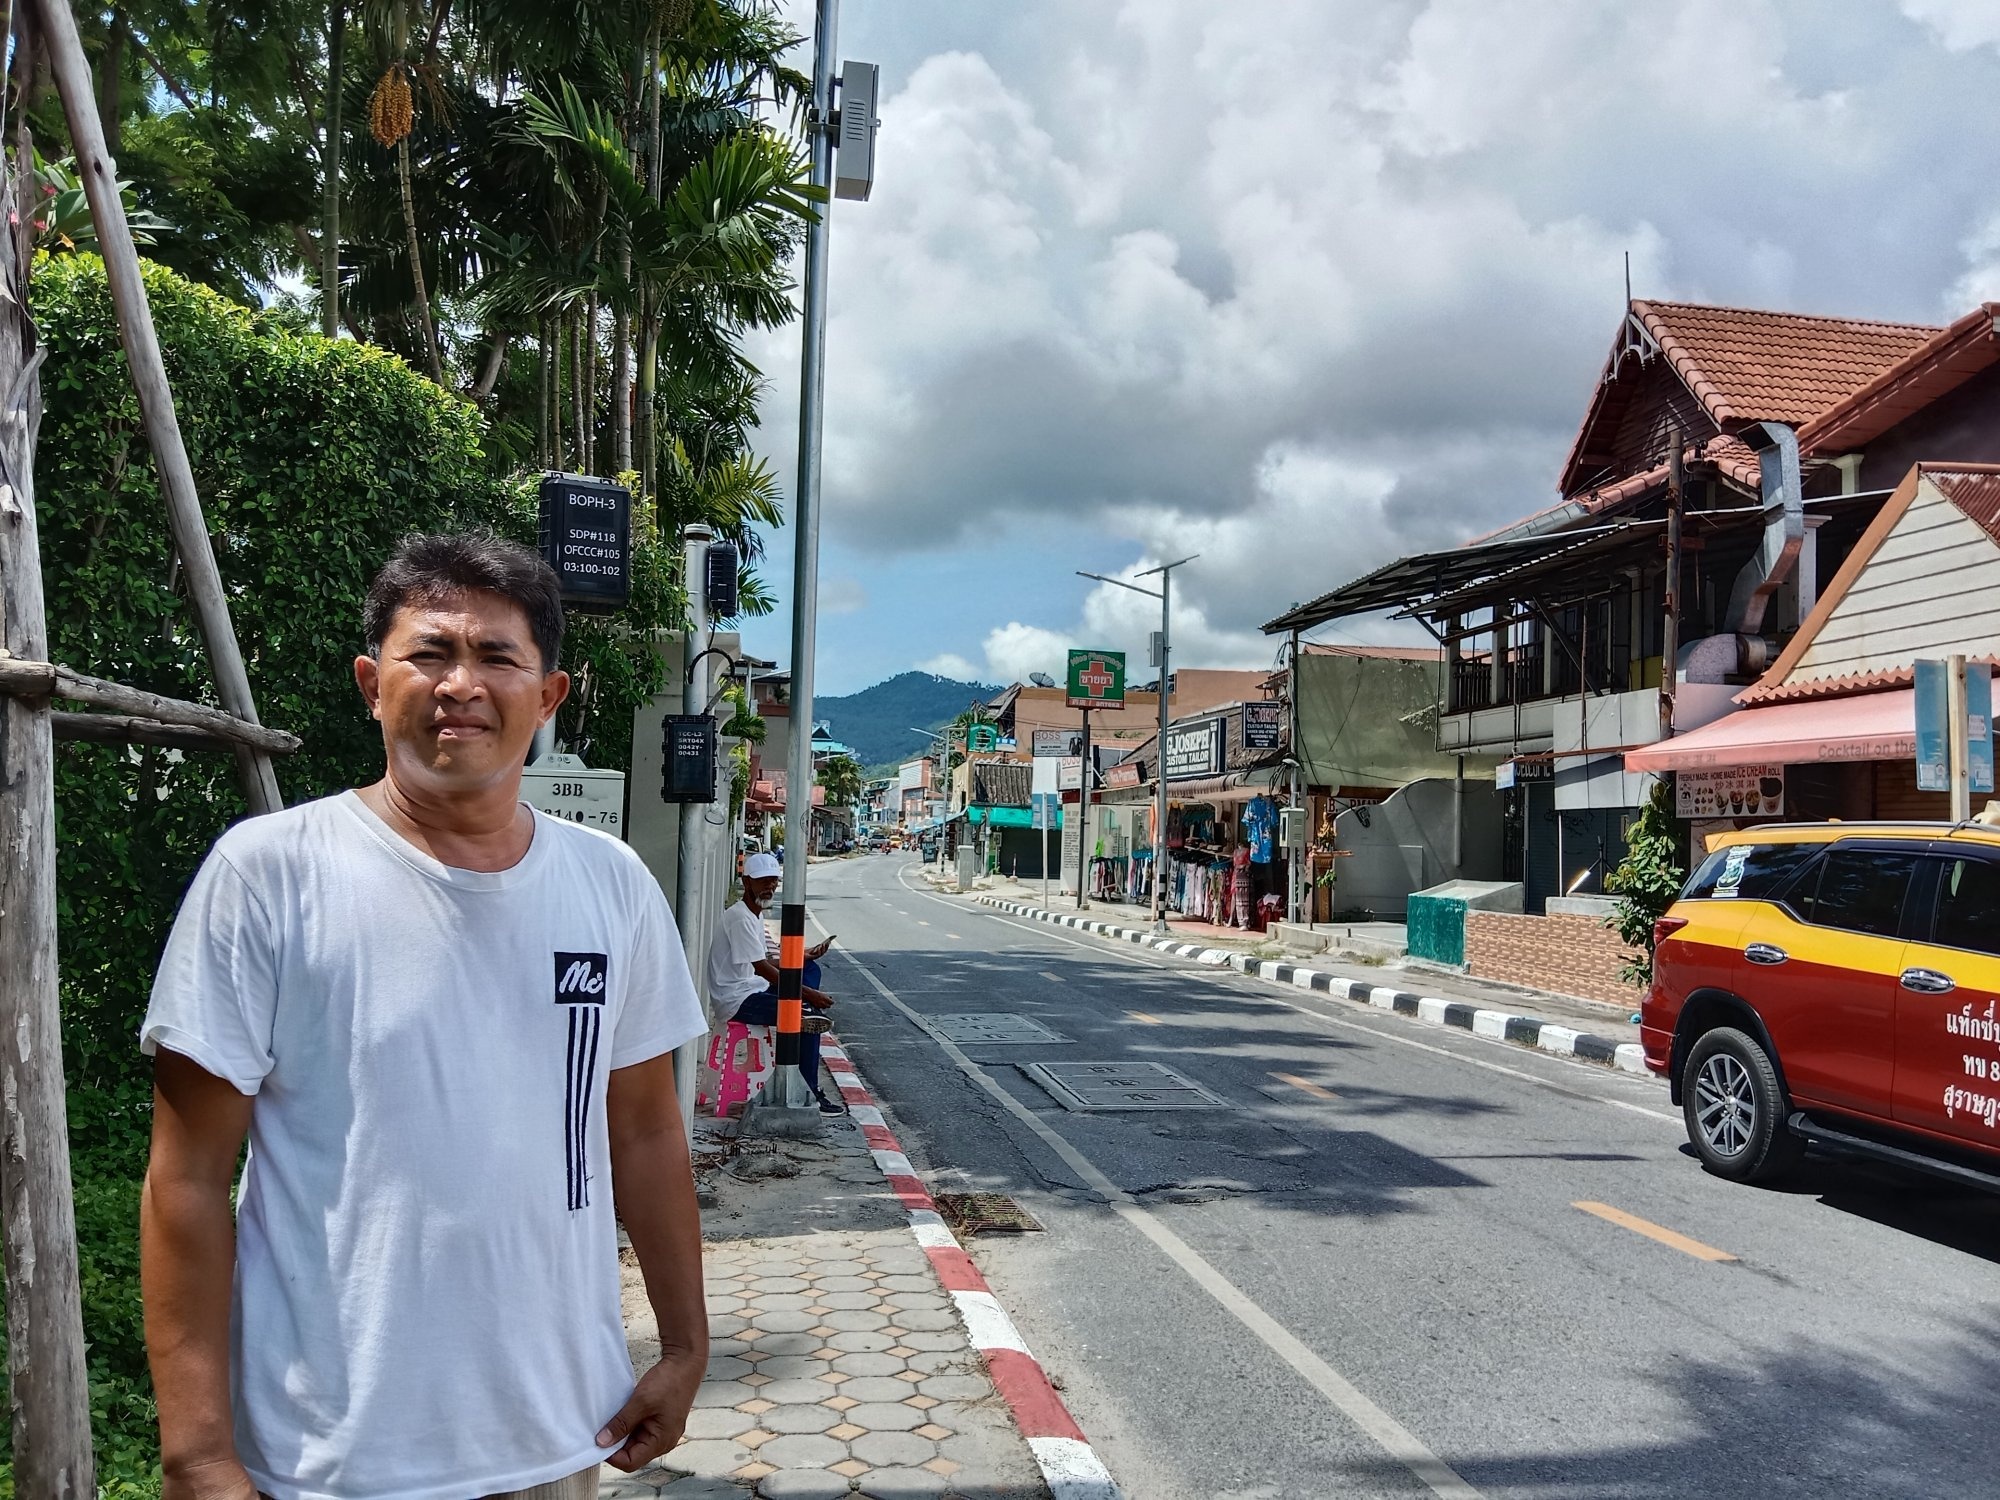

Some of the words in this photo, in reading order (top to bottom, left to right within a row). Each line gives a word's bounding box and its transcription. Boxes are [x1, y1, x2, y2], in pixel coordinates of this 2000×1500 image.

[569, 493, 616, 510] BOPH-3
[569, 528, 616, 542] SDP#118
[564, 544, 620, 559] OFCCC#105
[563, 561, 620, 576] 03:100-102
[1081, 675, 1112, 685] ขายยา
[1035, 731, 1061, 740] BOSS
[1166, 729, 1210, 756] G.JOSEPH
[1188, 750, 1209, 763] TAILOR
[1818, 742, 1870, 758] Cocktail
[1874, 744, 1890, 756] on
[1894, 740, 1916, 753] the
[1696, 772, 1709, 780] MADE
[1710, 771, 1723, 780] HOME
[1723, 770, 1736, 779] MADE
[1736, 767, 1746, 778] ICE
[1746, 765, 1767, 777] CREAM
[1767, 767, 1781, 776] ROLL
[552, 783, 583, 797] 3BB
[1943, 1084, 2000, 1128] สุราษฎ
